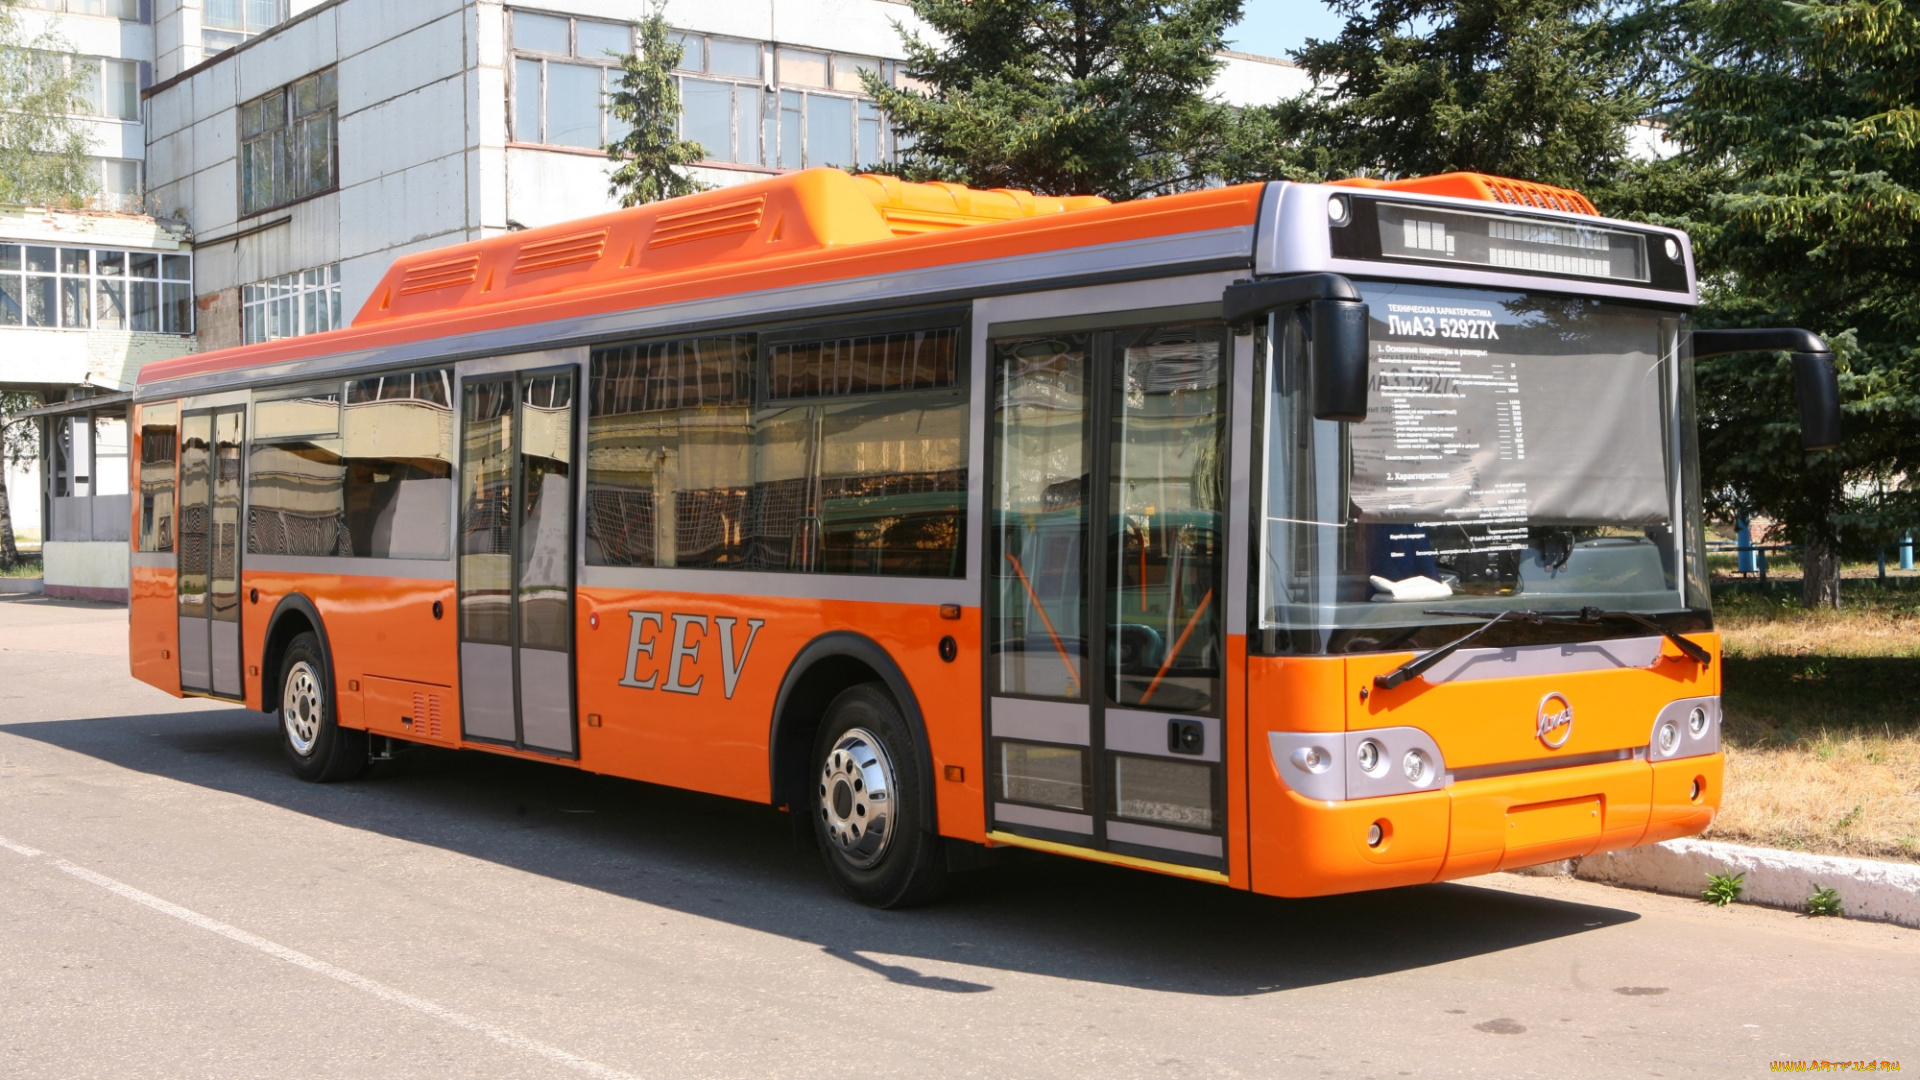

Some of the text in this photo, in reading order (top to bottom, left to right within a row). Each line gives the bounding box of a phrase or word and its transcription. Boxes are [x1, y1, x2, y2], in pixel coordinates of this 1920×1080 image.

[1388, 303, 1492, 318] ТЕХНИЧЕСКАЯ ХАРАКТЕРИСТИКА
[1388, 314, 1436, 337] ЛиАЗ
[1385, 344, 1418, 355] Основные
[1386, 472, 1394, 480] 2.
[618, 609, 765, 700] EEV
